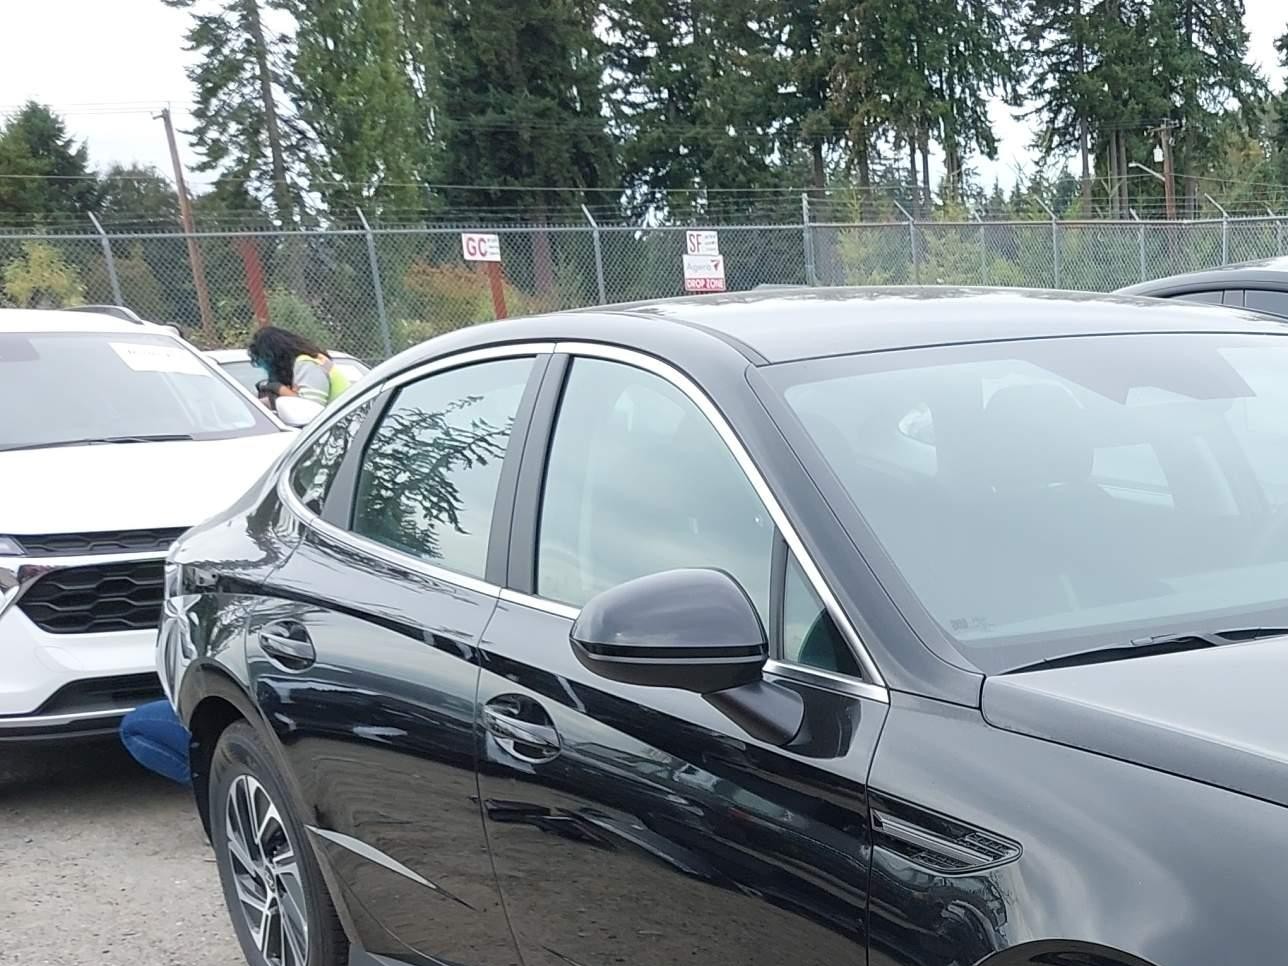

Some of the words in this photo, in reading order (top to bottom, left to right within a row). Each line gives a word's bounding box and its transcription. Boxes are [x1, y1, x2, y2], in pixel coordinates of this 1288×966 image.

[466, 237, 488, 256] GC
[689, 234, 702, 252] SF
[687, 280, 705, 289] DROP
